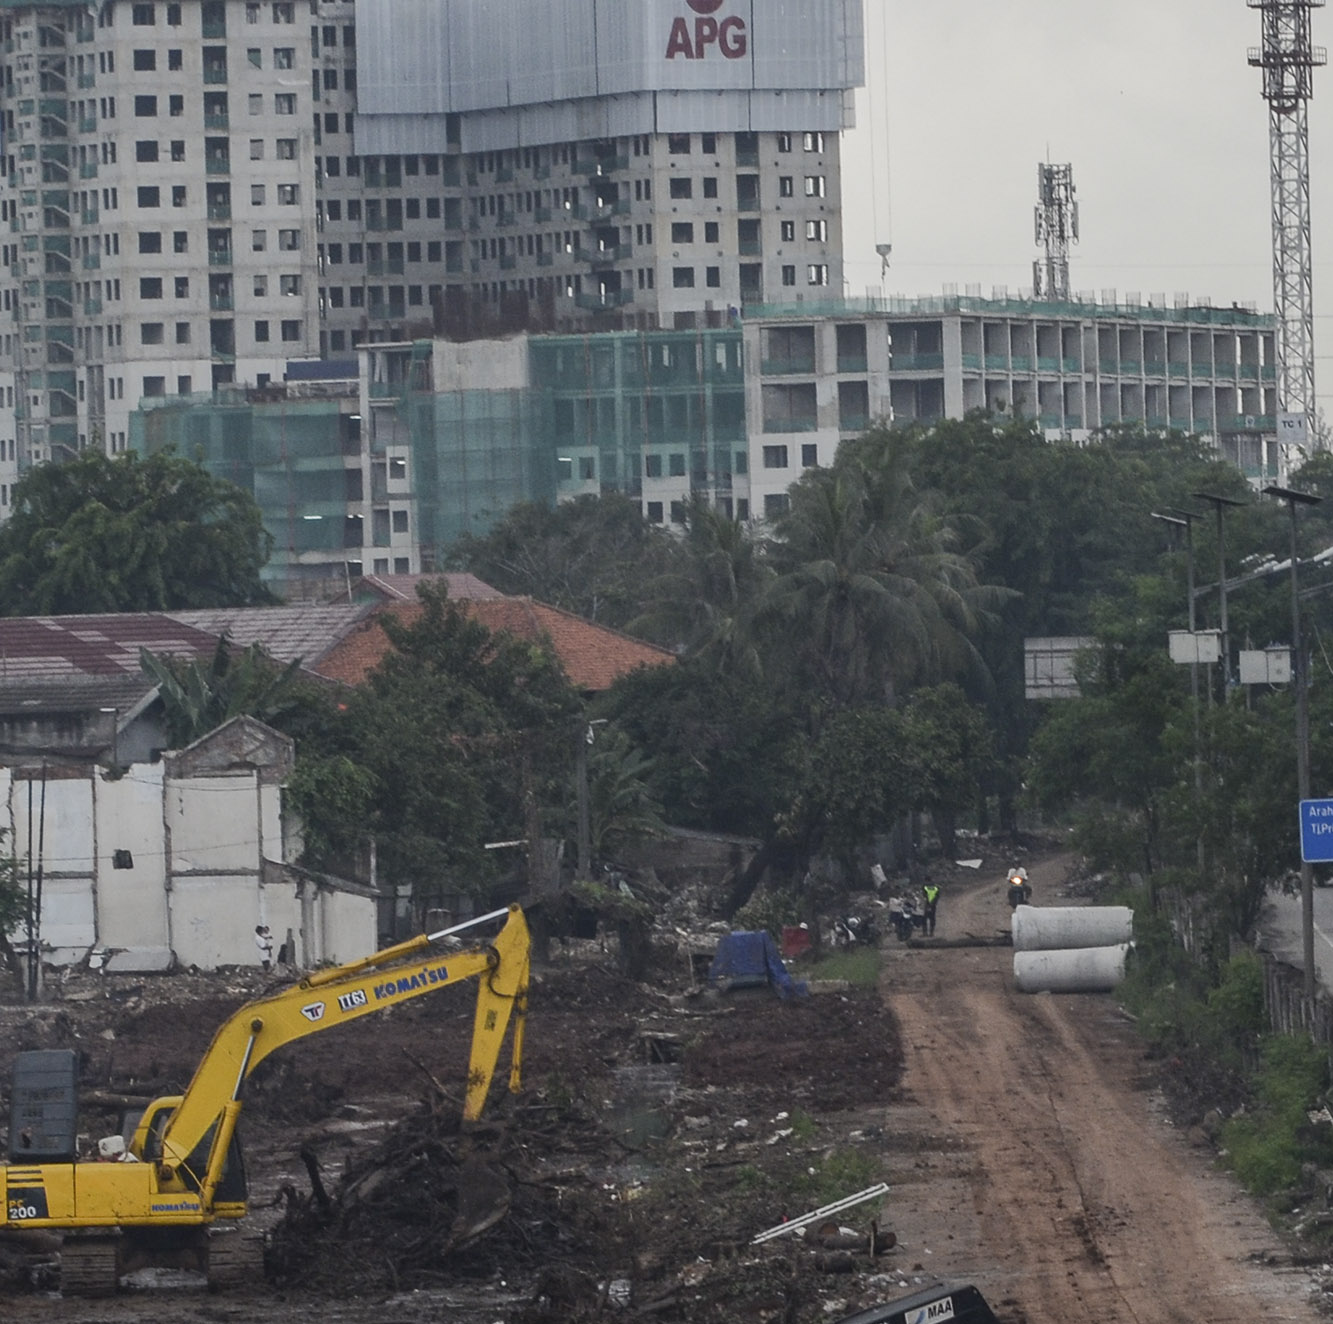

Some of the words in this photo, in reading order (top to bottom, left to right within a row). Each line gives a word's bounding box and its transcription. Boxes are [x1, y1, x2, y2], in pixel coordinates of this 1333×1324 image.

[665, 16, 746, 59] APG
[1309, 805, 1333, 817] Arah
[338, 990, 366, 1009] TT63
[373, 966, 448, 999] KOMATSU
[9, 1206, 37, 1219] 200
[152, 1200, 200, 1212] KOMATSU
[927, 1299, 952, 1319] MAA
